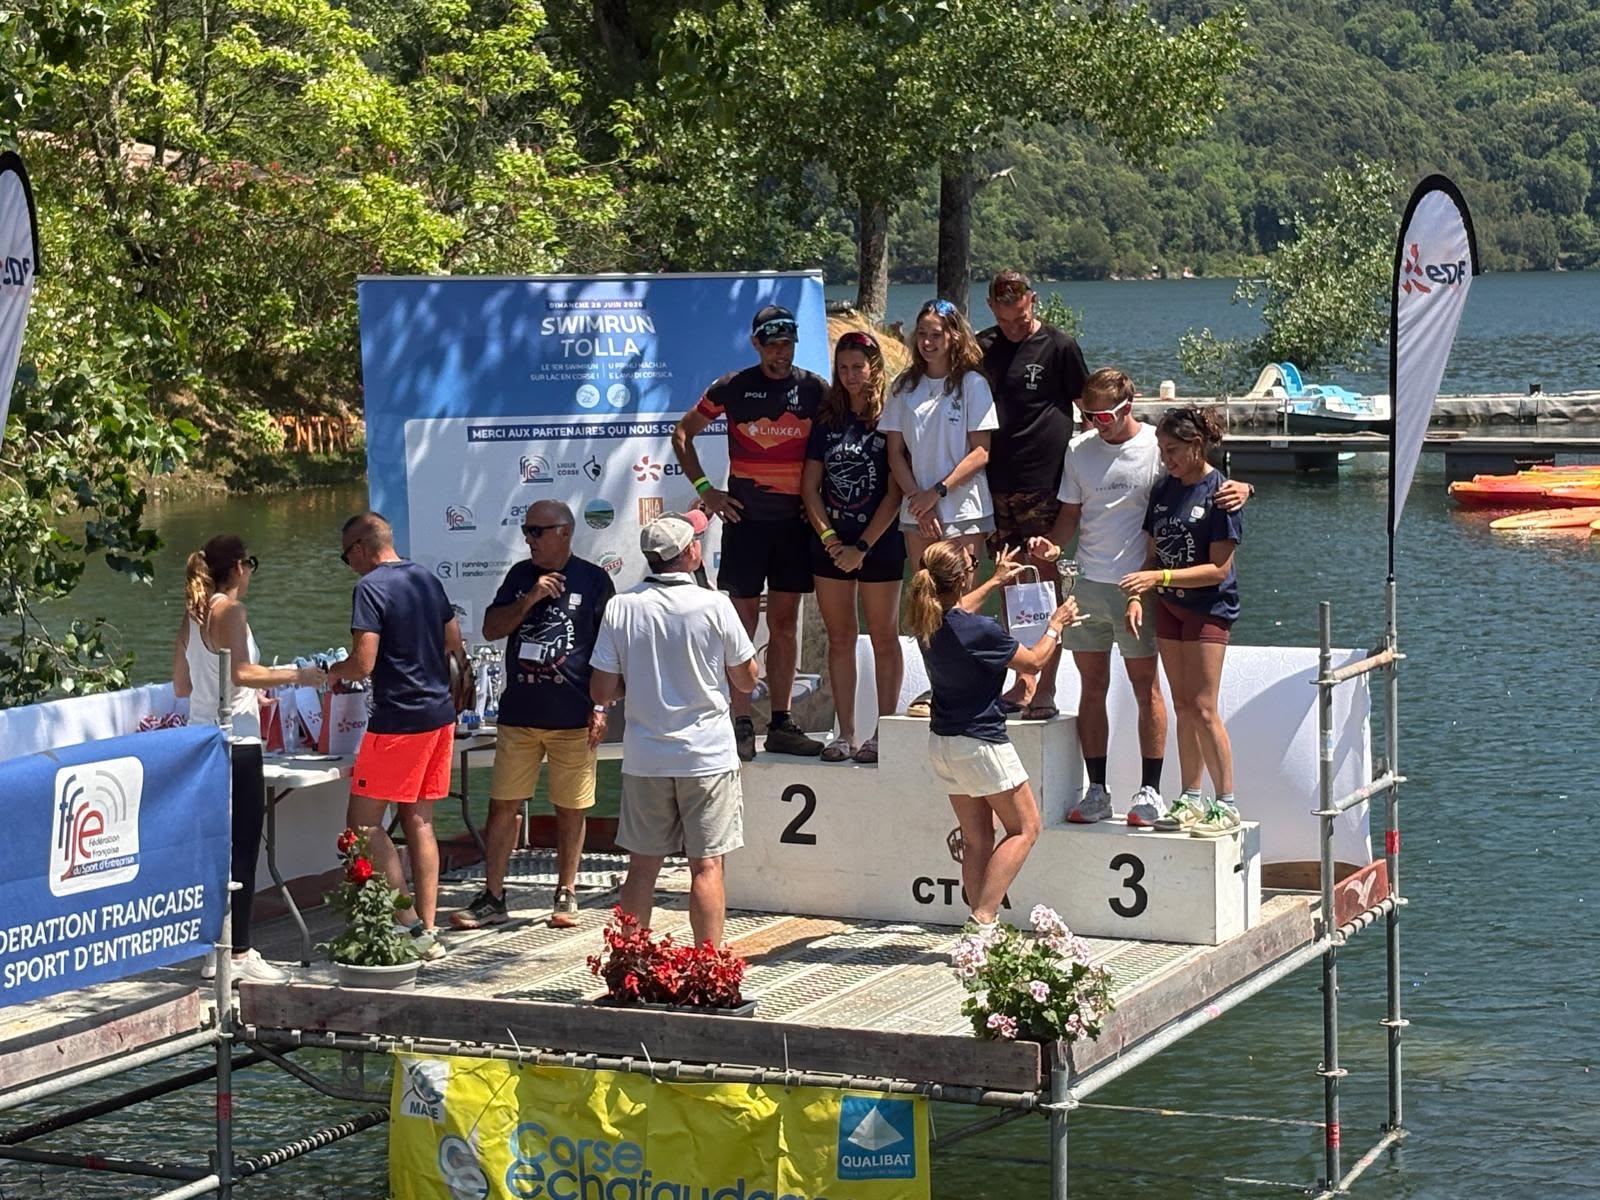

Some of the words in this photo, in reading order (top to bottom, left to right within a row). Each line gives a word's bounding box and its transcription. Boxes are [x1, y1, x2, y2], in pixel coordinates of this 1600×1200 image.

[549, 301, 589, 309] DIMANCHE
[541, 315, 655, 335] SWIMRUN
[561, 338, 640, 357] TOLLA
[472, 428, 506, 439] MERCI
[508, 428, 530, 438] AUX
[532, 426, 605, 438] PARTENAIRES
[607, 425, 627, 437] QUI
[629, 425, 659, 435] NOUS
[760, 426, 802, 437] LINXEA
[663, 463, 684, 476] eD
[1184, 532, 1196, 562] TOLLA
[564, 619, 575, 649] TOLLA
[780, 783, 817, 846] 2
[73, 865, 82, 876] du
[82, 862, 99, 876] Sport
[912, 876, 1012, 910] CT
[1108, 852, 1148, 918] 3
[101, 884, 205, 931] FRANCAISE
[3, 949, 70, 990] SPORT
[74, 917, 202, 972] D'ENTREPRISE
[409, 1100, 439, 1120] MAE
[509, 1121, 643, 1174] Corse
[841, 1153, 912, 1168] QUALIBAT
